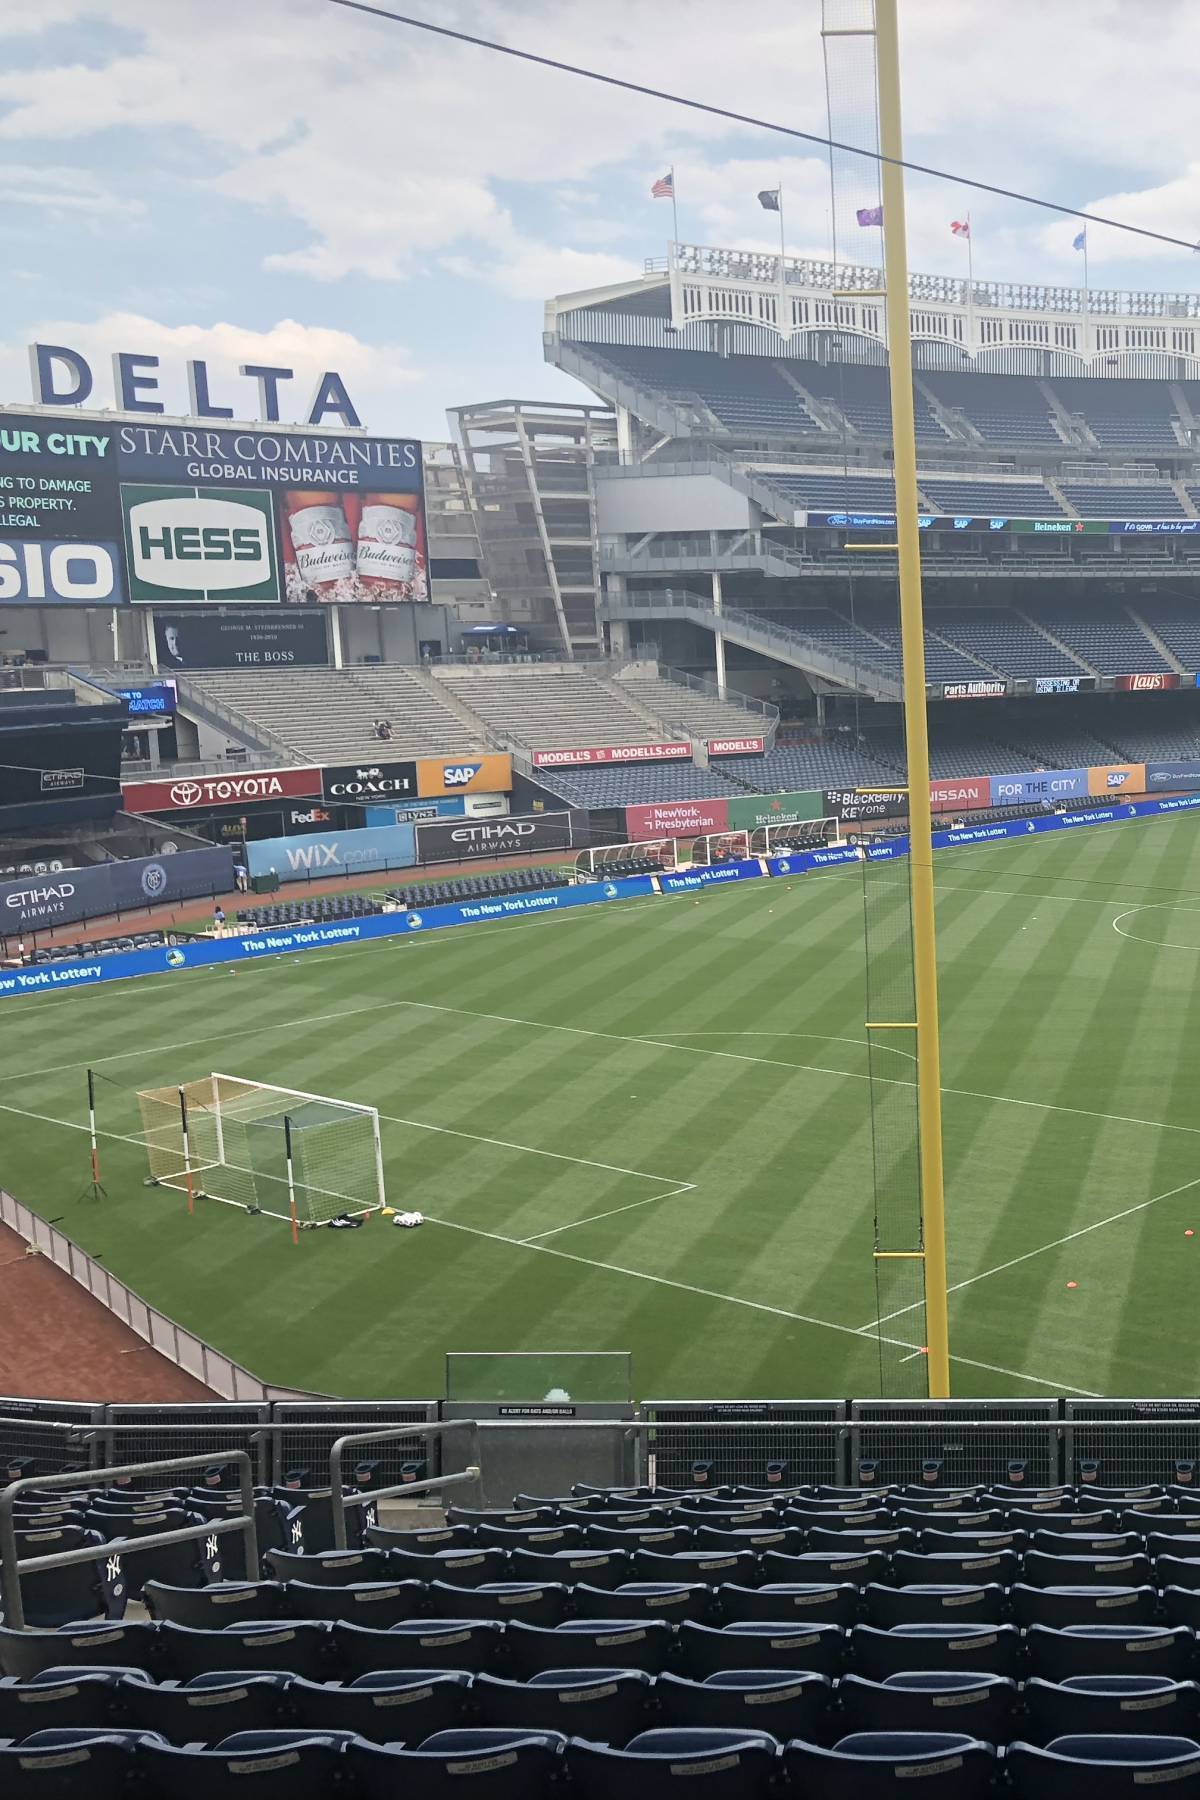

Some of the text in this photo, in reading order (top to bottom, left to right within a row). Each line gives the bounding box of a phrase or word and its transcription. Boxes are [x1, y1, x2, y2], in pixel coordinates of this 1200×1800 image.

[30, 343, 361, 427] DELTA
[47, 433, 110, 457] CITY
[119, 426, 416, 468] STARR COMPANIES
[187, 462, 359, 484] GLOBAL INSURANCE
[16, 477, 35, 490] TO
[40, 479, 92, 493] DAMAGE
[9, 496, 76, 511] PROPERTY.
[918, 519, 932, 527] SAP
[954, 519, 969, 529] SAP
[990, 520, 1004, 530] SAP
[1034, 522, 1072, 532] Heineken
[139, 526, 262, 561] HESS
[236, 651, 295, 662] THE BOSS
[944, 682, 1005, 695] Parts Authority
[713, 740, 759, 751] MODELL'S
[537, 745, 687, 764] MODELL'S MODELLS.com
[43, 770, 83, 782] ETIHAD
[444, 768, 474, 785] SAP
[1107, 773, 1126, 786] SAP
[204, 777, 283, 800] TOYOTA
[330, 778, 410, 795] COACH
[998, 783, 1022, 796] FOR
[1025, 781, 1048, 794] THE
[929, 787, 978, 802] NISSAN
[1159, 801, 1168, 809] The
[1168, 800, 1179, 808] New
[1179, 799, 1188, 807] York
[291, 808, 330, 824] FedEx
[407, 809, 435, 820] LYNX
[654, 807, 701, 819] NewYork-
[755, 811, 798, 824] Heineken
[1062, 811, 1113, 825] The New York Lottery
[654, 815, 714, 830] Presbyterian
[451, 823, 536, 842] ETIHAD
[973, 829, 987, 838] York
[987, 828, 1007, 836] Lottery
[467, 838, 521, 853] AIRWAYS
[813, 854, 827, 863] The
[868, 848, 893, 857] Lottery
[668, 878, 685, 888] The
[685, 876, 701, 886] New
[710, 868, 739, 879] Lottery
[6, 883, 75, 908] ETIHAD
[20, 902, 65, 920] AIRWAYS
[460, 896, 559, 918] The New York Lottery
[242, 926, 360, 952] The New York Lottery
[17, 972, 50, 987] York
[51, 966, 101, 981] Lottery
